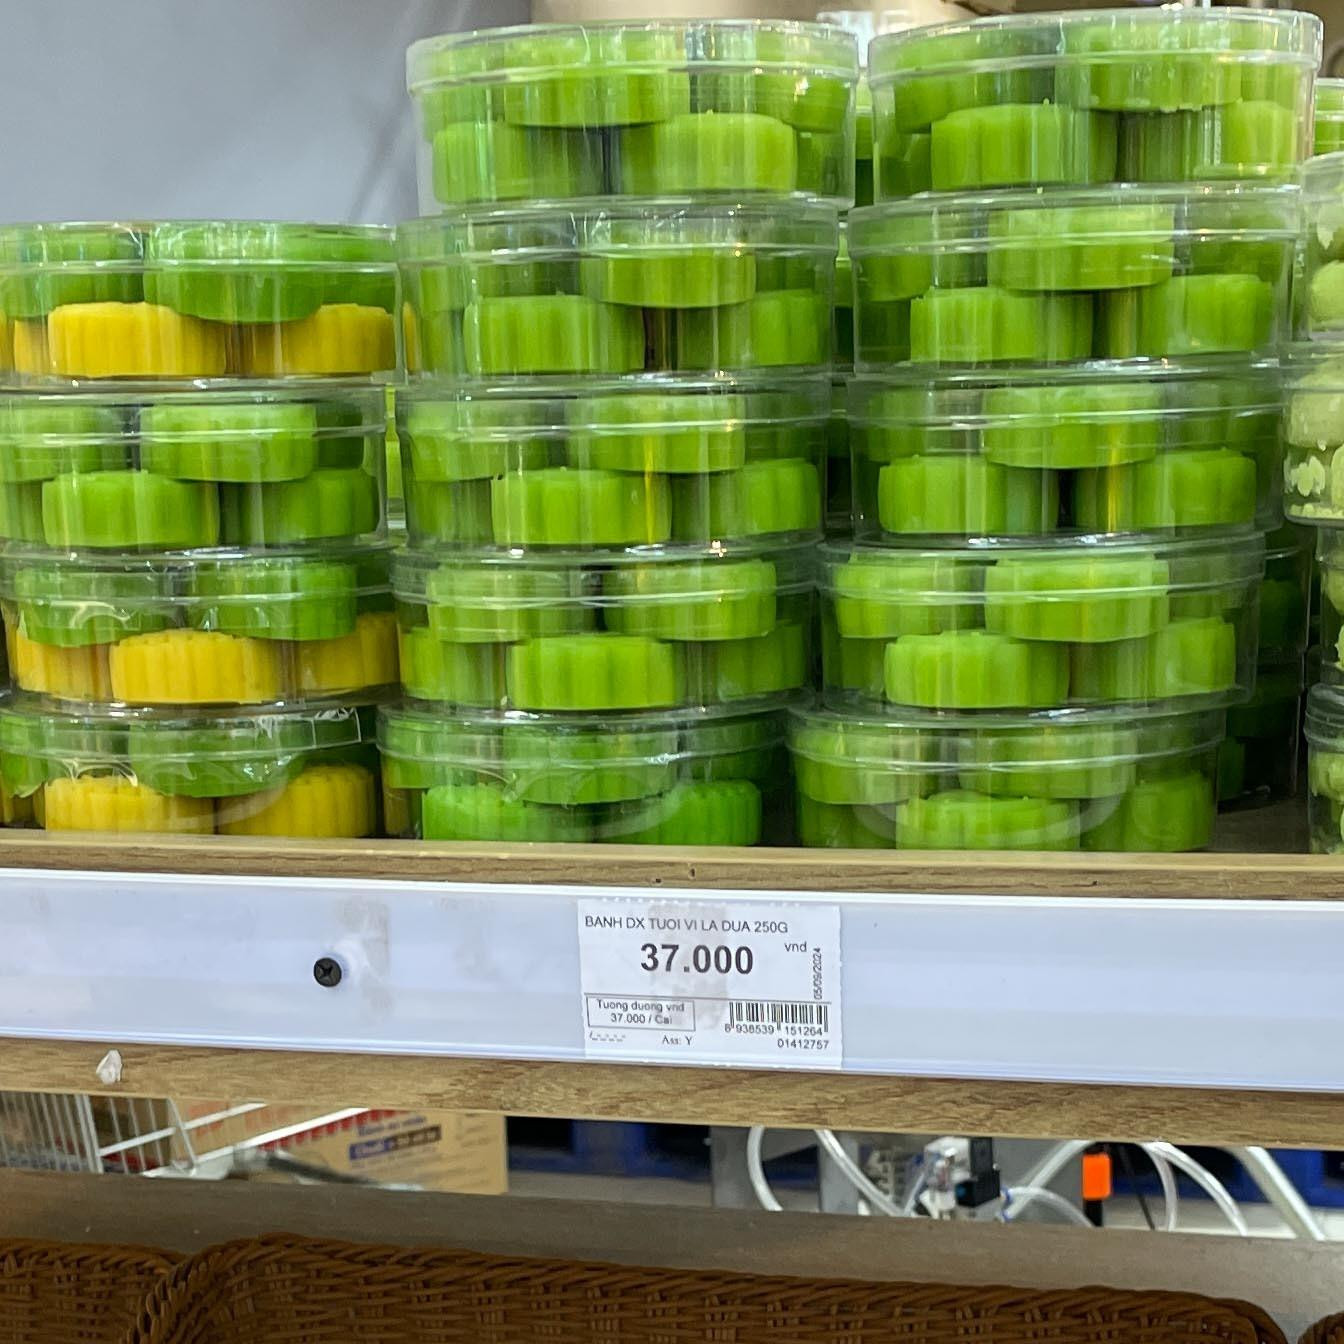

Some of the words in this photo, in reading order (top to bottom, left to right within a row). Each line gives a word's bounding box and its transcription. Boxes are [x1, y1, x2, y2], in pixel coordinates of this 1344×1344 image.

[585, 916, 622, 929] BANH
[626, 917, 645, 929] DX
[649, 918, 680, 931] TUOI
[685, 919, 698, 931] VI
[702, 919, 718, 932] LA
[722, 920, 750, 933] DUA
[754, 920, 788, 933] 250G
[784, 942, 807, 953] vnd
[640, 943, 753, 975] 37.000
[597, 1000, 628, 1011] Tuong
[631, 1001, 662, 1012] duong
[666, 1002, 684, 1012] vnd
[611, 1013, 646, 1024] 37.000
[736, 1024, 774, 1035] 938539
[785, 1026, 822, 1036] 151264
[685, 1035, 693, 1046] Y
